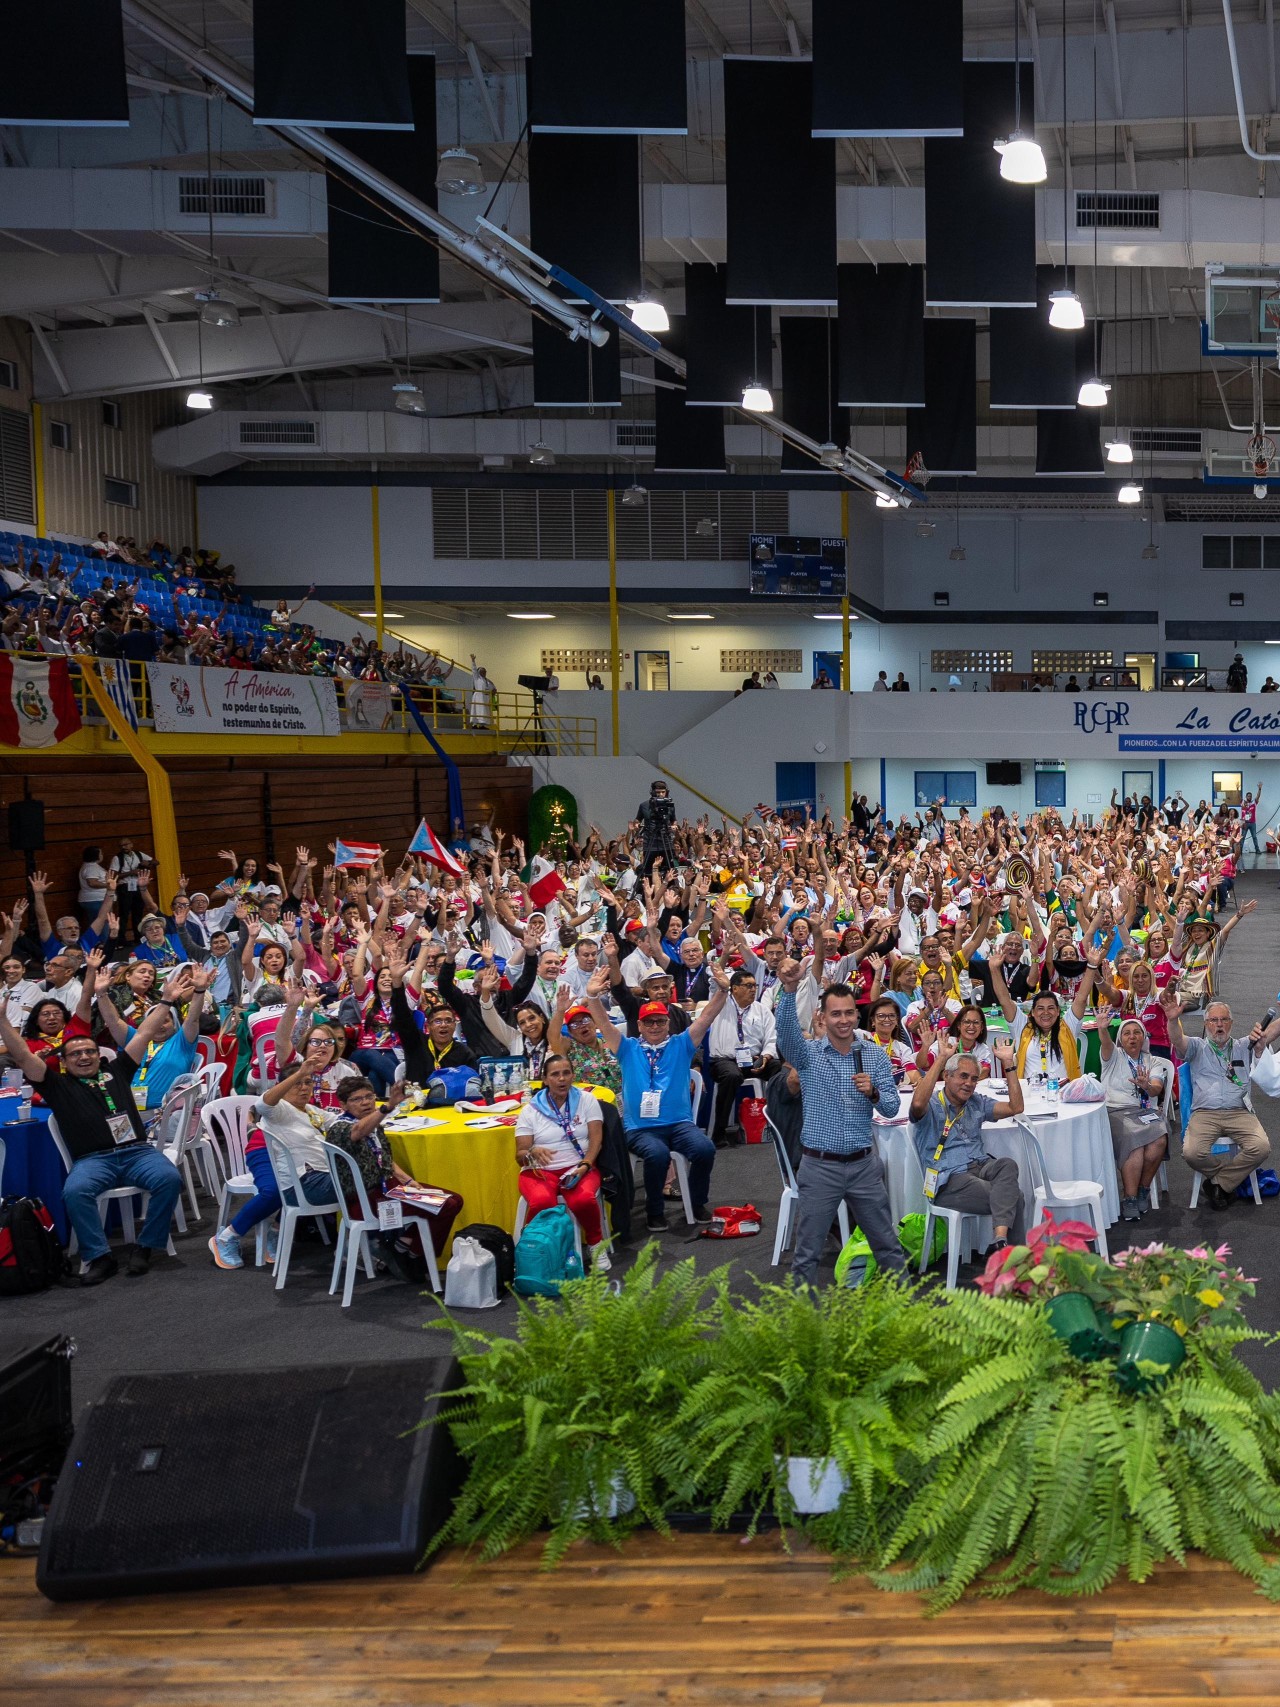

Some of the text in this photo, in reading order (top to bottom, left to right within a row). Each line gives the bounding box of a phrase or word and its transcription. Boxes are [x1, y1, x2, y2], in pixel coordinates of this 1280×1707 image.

[224, 670, 295, 700] A América,
[222, 703, 302, 715] no poder do Espírito,
[222, 718, 307, 730] testemunha de Cristo.
[1175, 706, 1211, 730] La
[1229, 738, 1258, 747] ESPÍRITU
